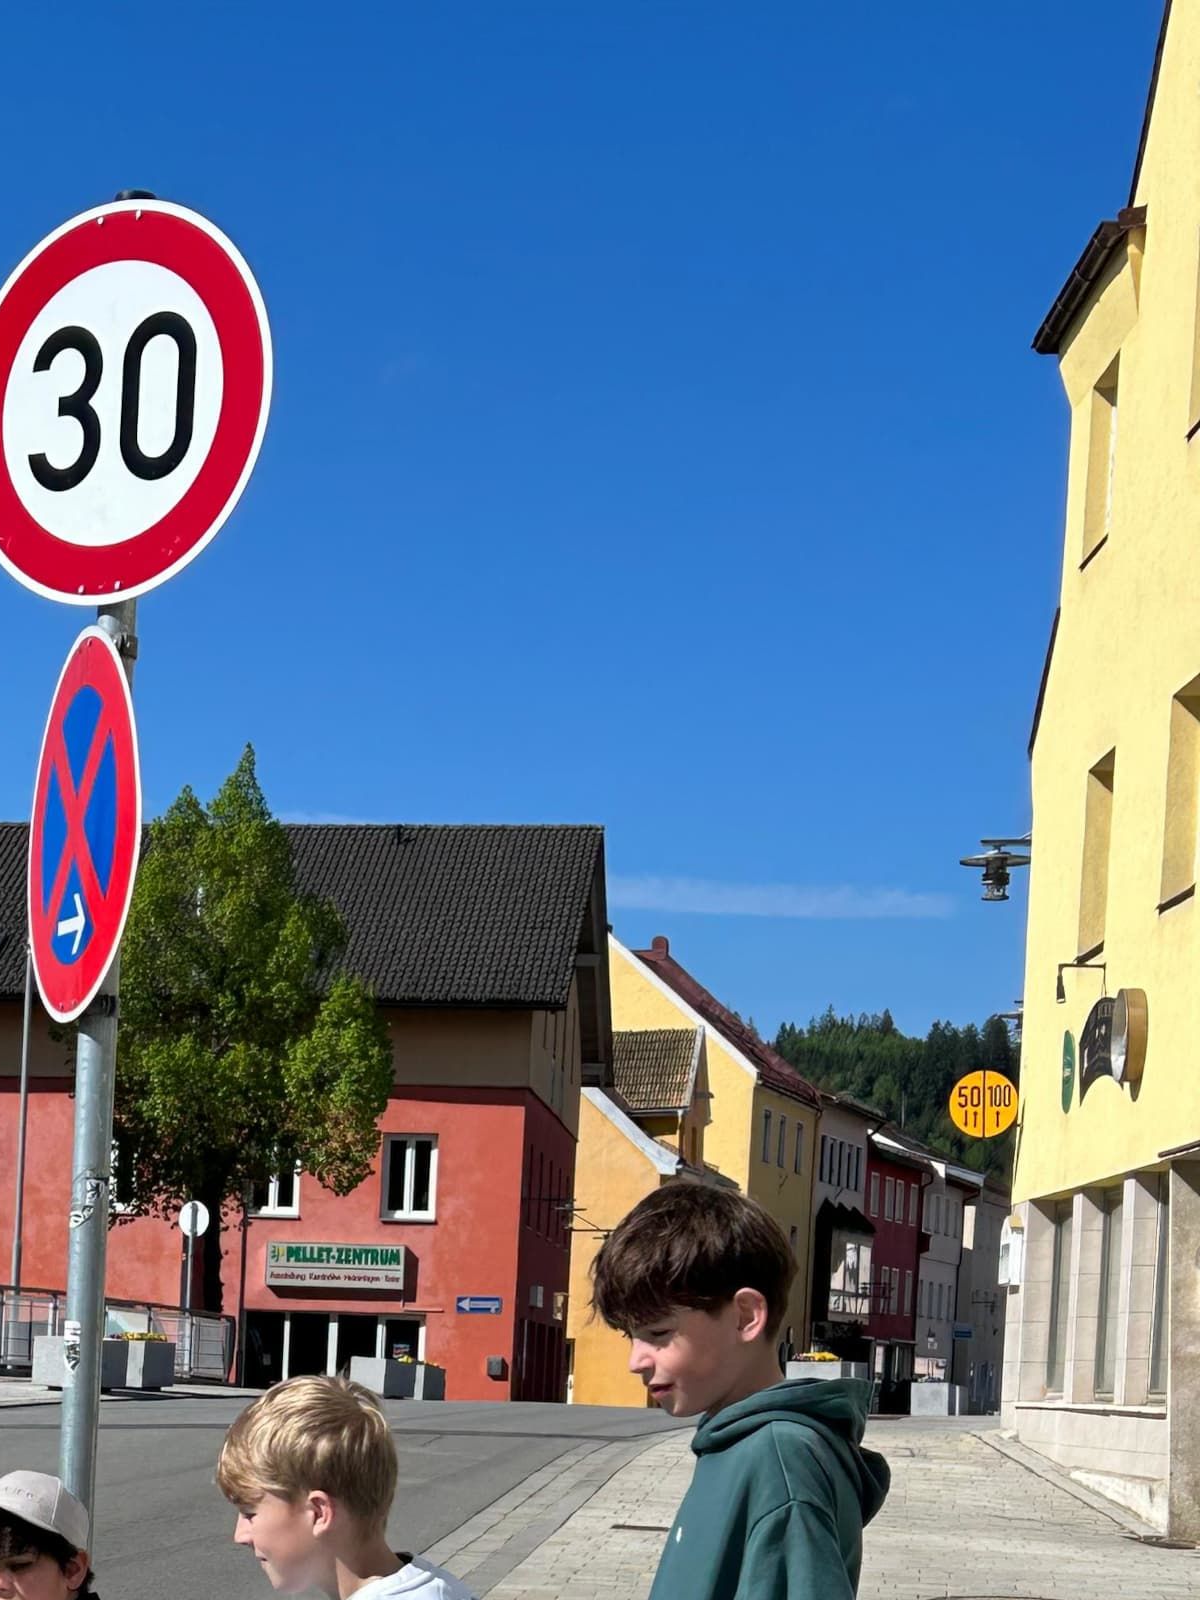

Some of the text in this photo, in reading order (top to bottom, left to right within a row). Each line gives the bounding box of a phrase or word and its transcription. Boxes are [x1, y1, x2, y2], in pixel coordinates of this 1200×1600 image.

[28, 311, 197, 492] 30
[958, 1084, 1011, 1108] 50 100
